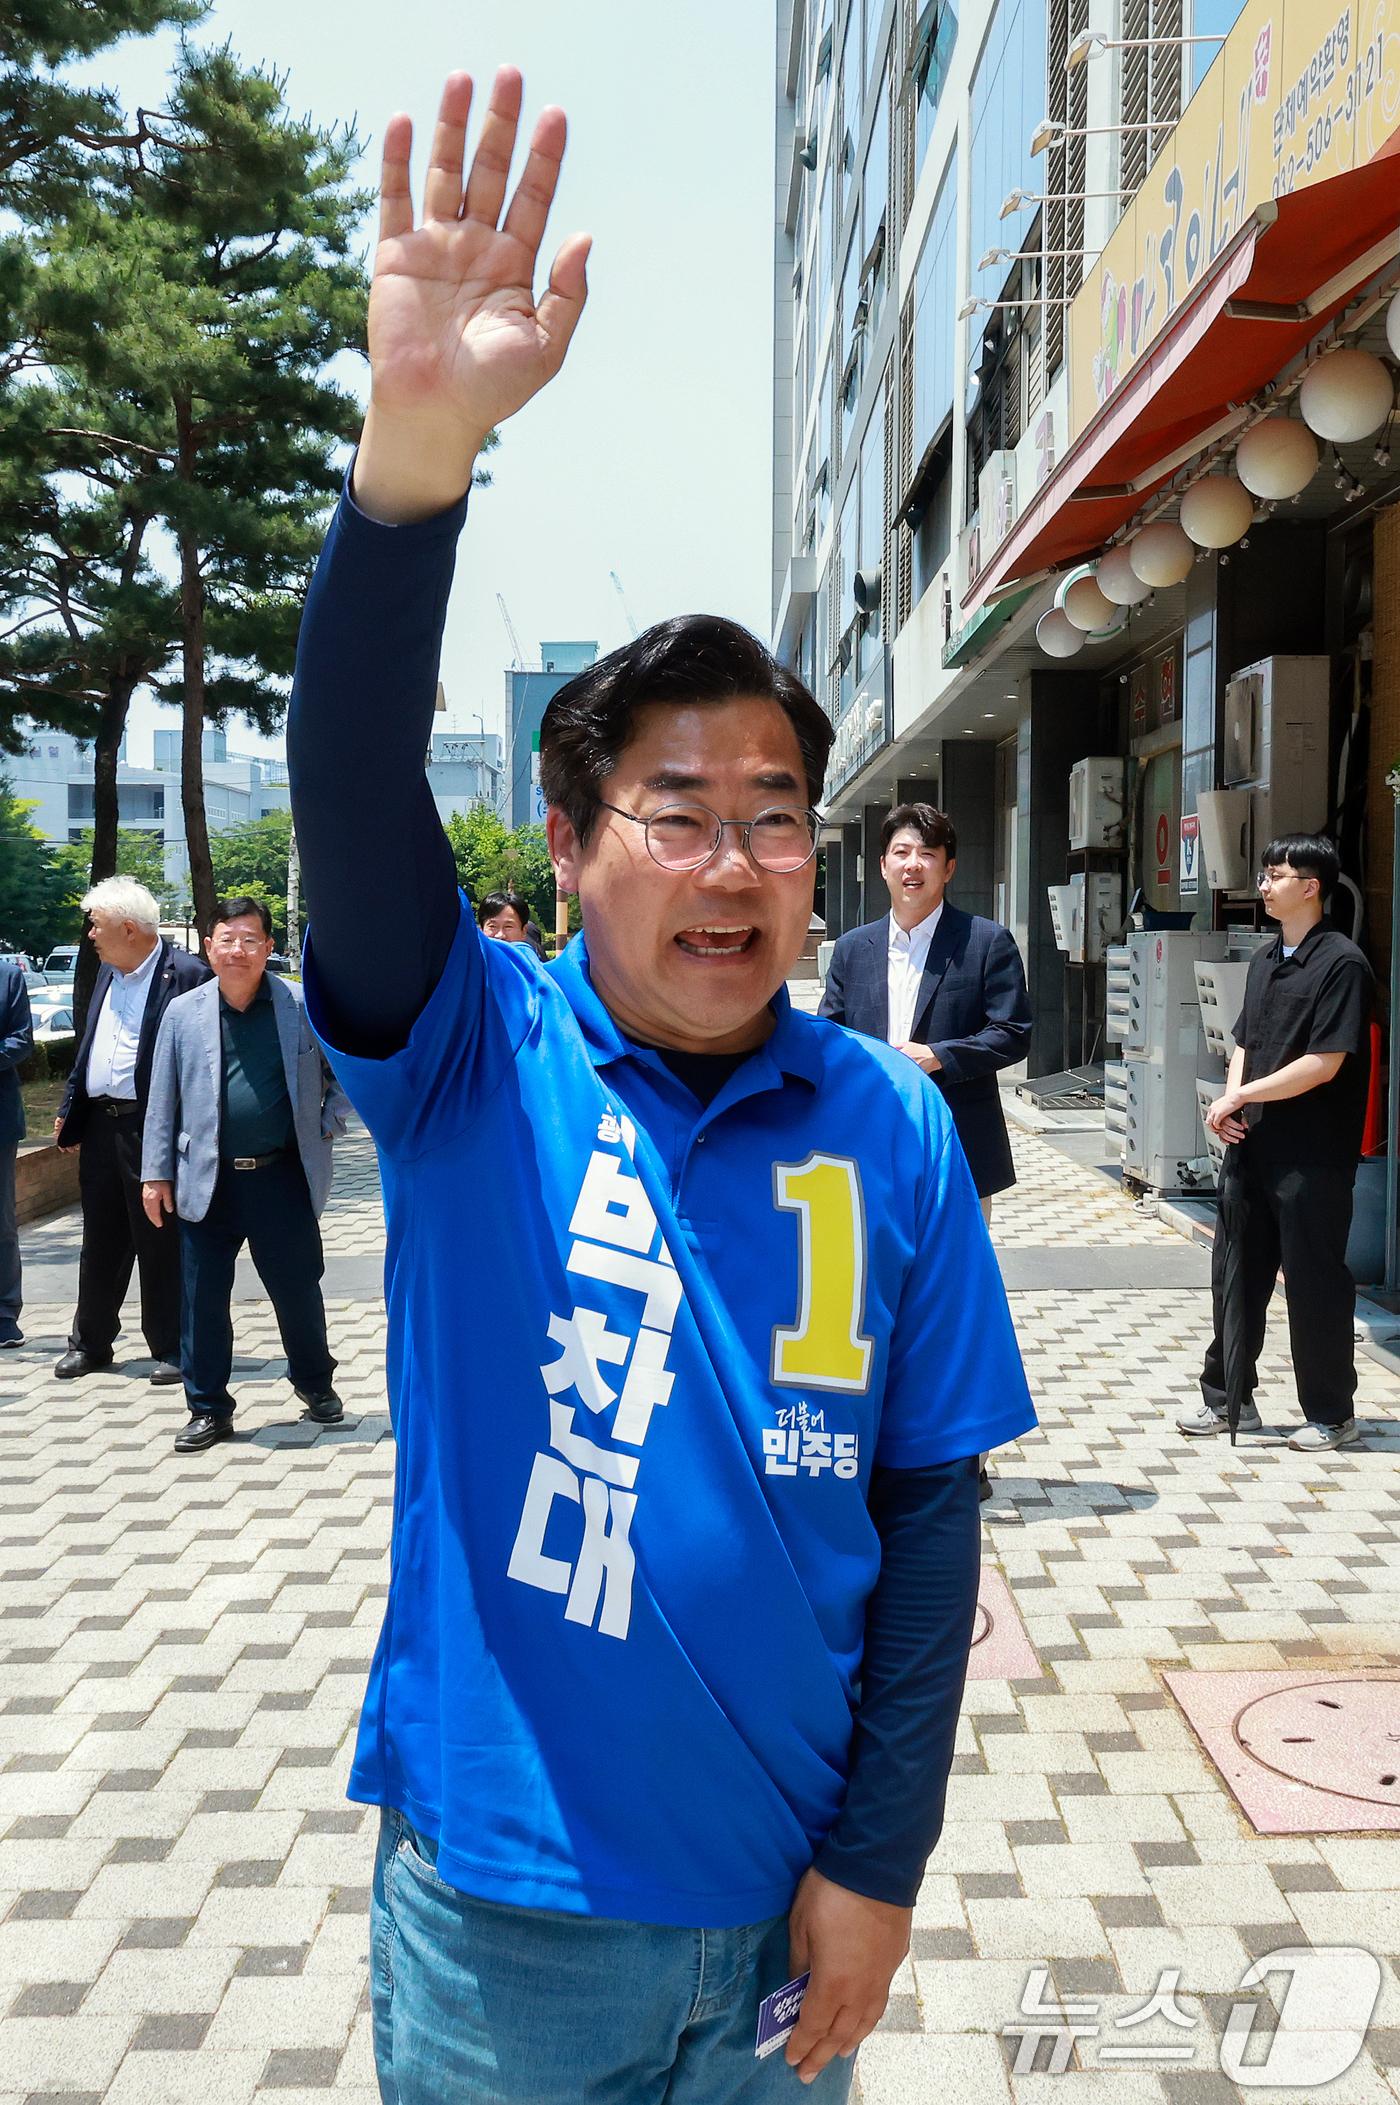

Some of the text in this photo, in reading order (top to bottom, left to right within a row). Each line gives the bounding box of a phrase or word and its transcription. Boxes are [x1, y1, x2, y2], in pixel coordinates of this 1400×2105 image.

[1273, 7, 1350, 160] 단체예약환영
[771, 1150, 875, 1396] 1
[507, 1150, 683, 1640] 박찬대
[761, 1428, 858, 1480] 민주당
[775, 1400, 825, 1432] 더불어
